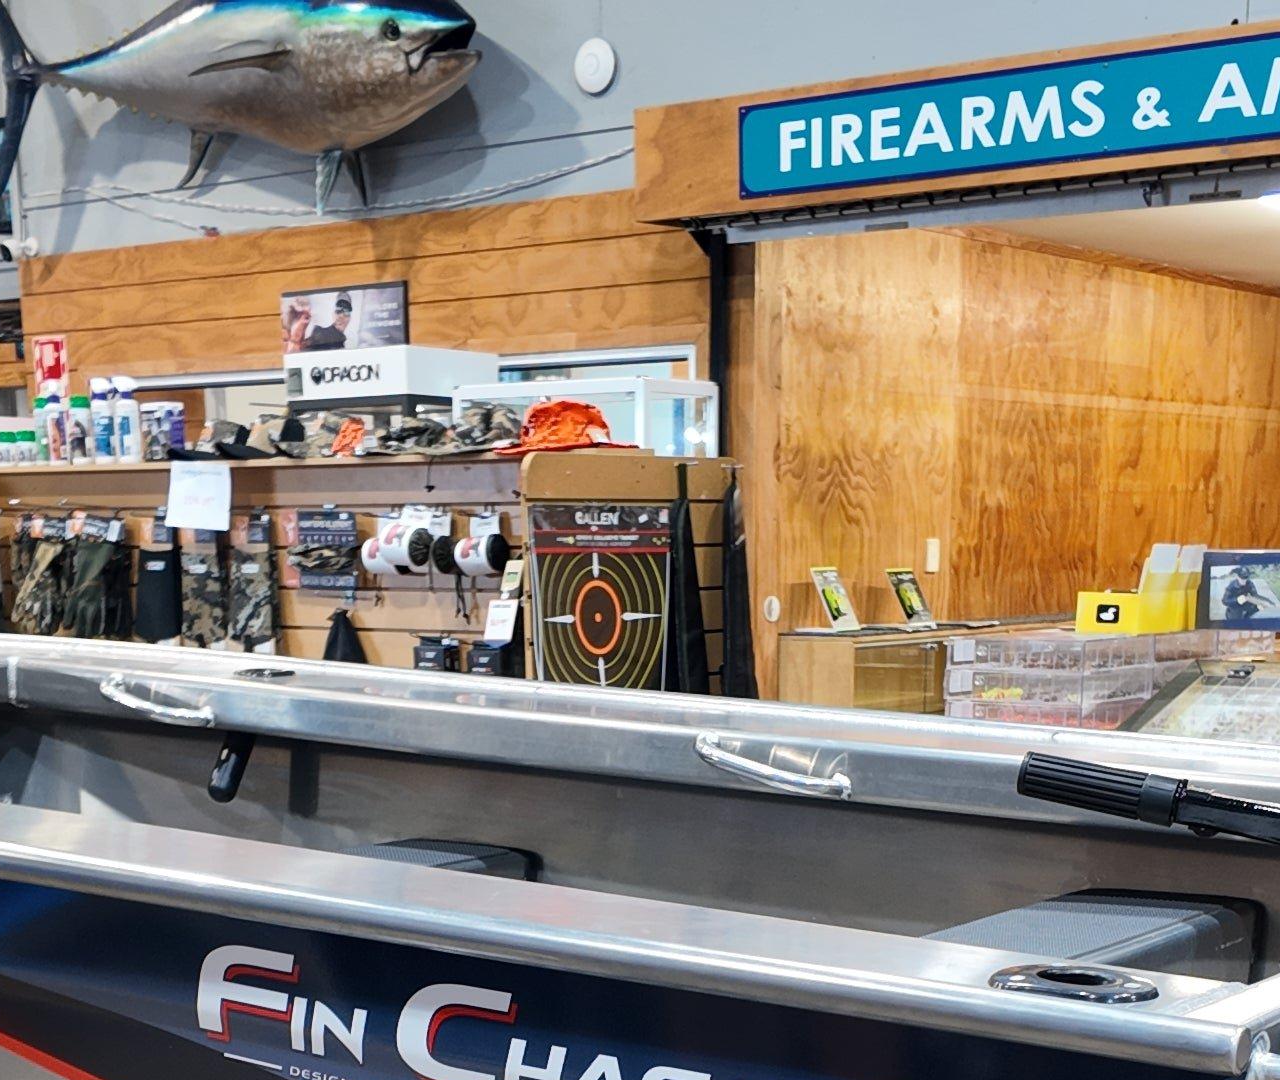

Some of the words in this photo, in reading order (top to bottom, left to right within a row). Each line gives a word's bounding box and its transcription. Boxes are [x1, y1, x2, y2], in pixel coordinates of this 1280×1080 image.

[779, 80, 1106, 172] FIREARMS
[1131, 86, 1170, 130] &
[323, 364, 381, 384] DRAGON
